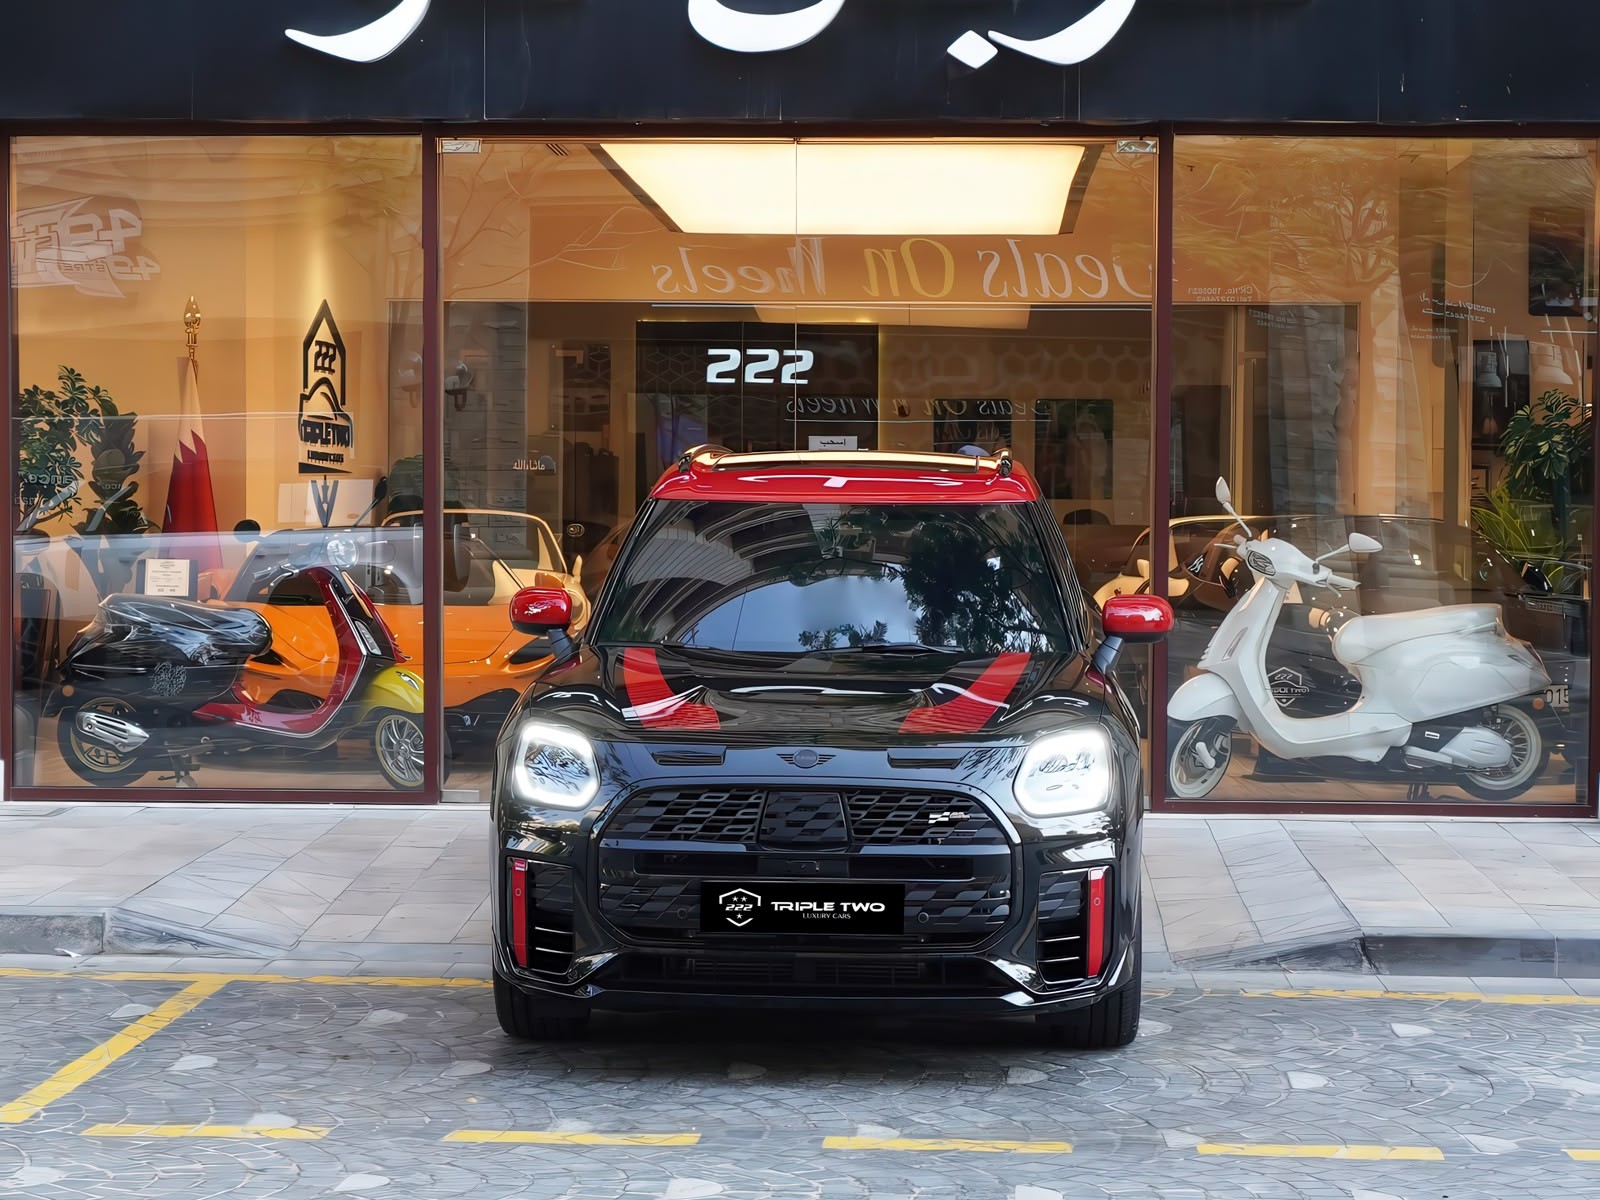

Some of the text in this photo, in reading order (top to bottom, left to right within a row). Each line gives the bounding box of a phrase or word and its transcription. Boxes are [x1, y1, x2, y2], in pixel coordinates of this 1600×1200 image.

[706, 348, 814, 385] 222
[725, 901, 886, 912] 222 TRIPLE TWO
[802, 912, 831, 920] LUXURY
